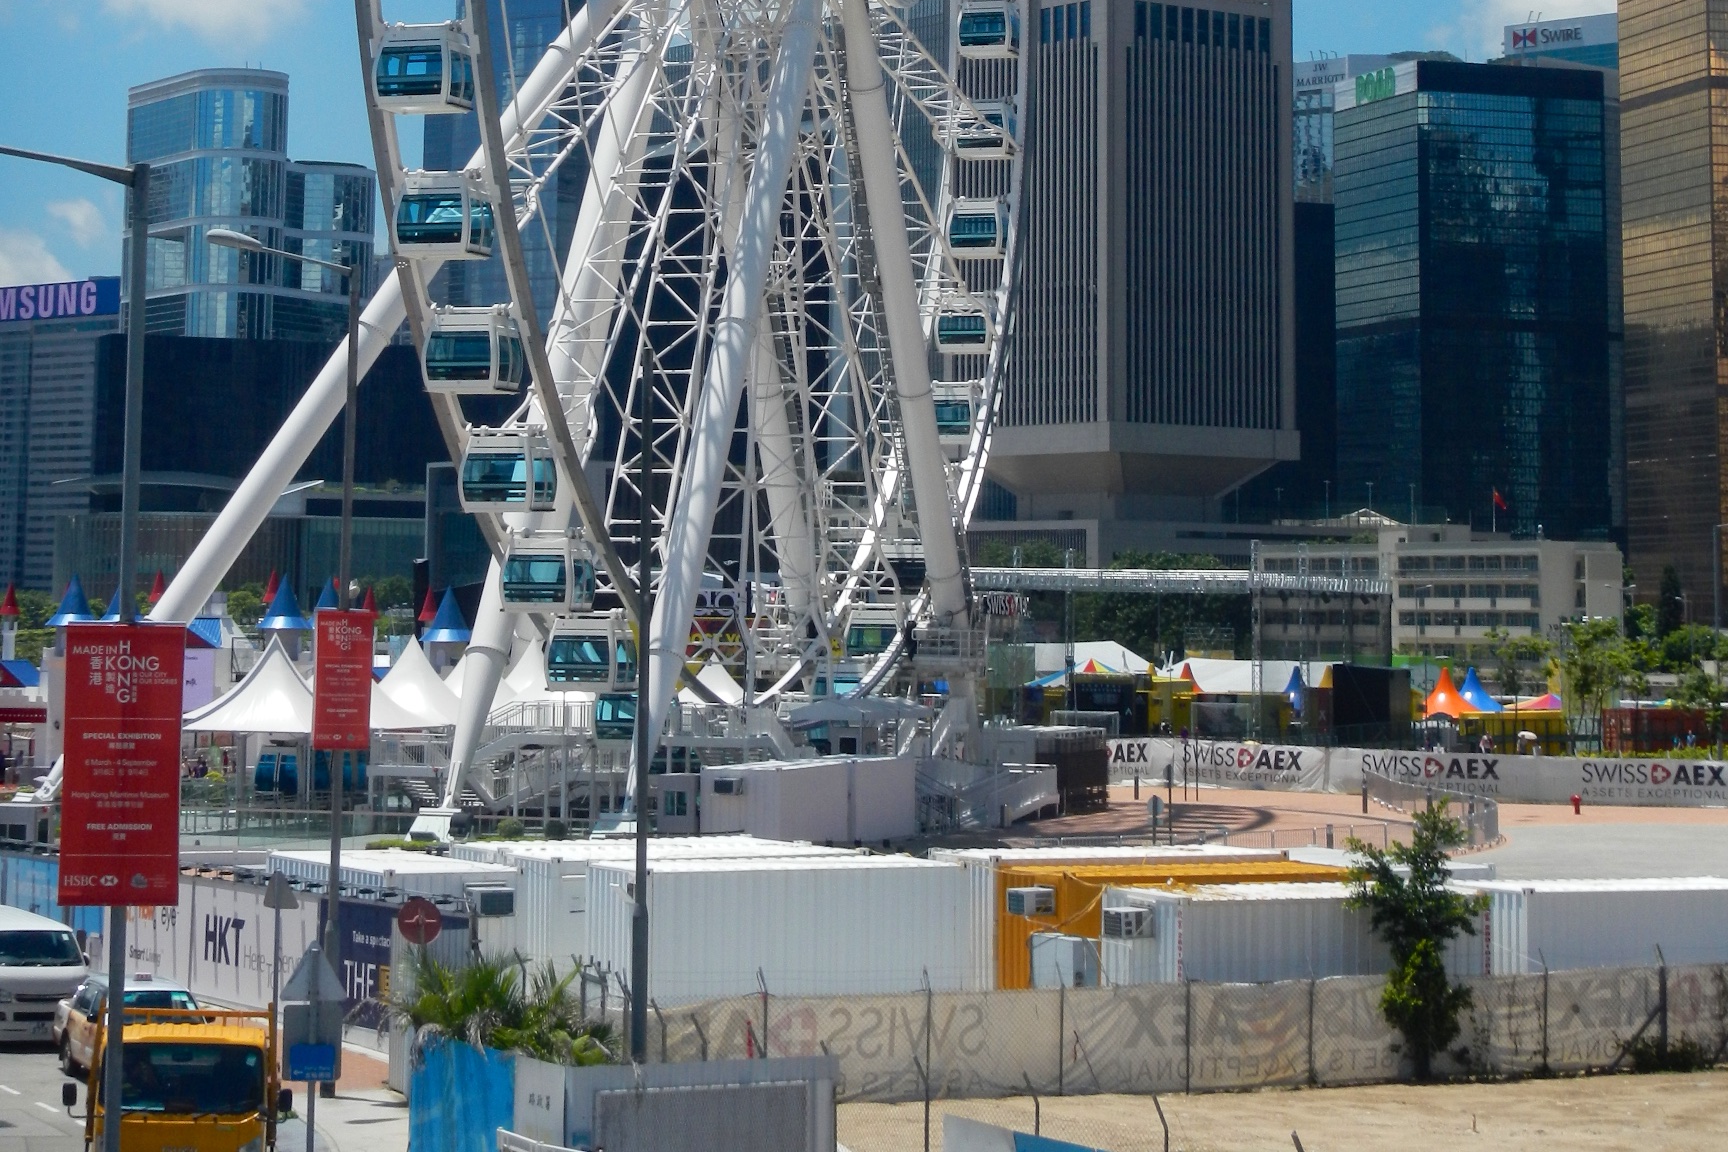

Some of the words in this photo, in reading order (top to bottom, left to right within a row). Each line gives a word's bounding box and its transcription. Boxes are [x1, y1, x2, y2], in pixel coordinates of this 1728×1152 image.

[1313, 63, 1328, 72] JW
[1297, 74, 1345, 86] MARRIOTT
[0, 281, 97, 320] MSUNG
[72, 645, 104, 654] MADE
[105, 645, 117, 654] IN
[89, 656, 103, 686] 香港
[105, 656, 160, 671] KONG
[117, 732, 162, 740] EXHIBITION
[1113, 743, 1148, 762] AEX
[1183, 744, 1234, 767] SWISS
[1255, 750, 1302, 771] AEX
[1362, 754, 1421, 777] SWISS
[1446, 758, 1500, 780] AEX
[1582, 763, 1648, 784] SWISS
[1673, 765, 1726, 787] AEX
[1183, 768, 1221, 779] ASSETS
[1226, 772, 1302, 784] EXCEPTIONAL
[1582, 787, 1630, 798] ASSETS
[1638, 789, 1727, 800] EXCEPTIONAL
[64, 875, 98, 887] HSBC
[204, 913, 245, 967] HKT
[353, 930, 365, 944] Take
[343, 959, 377, 1000] THE
